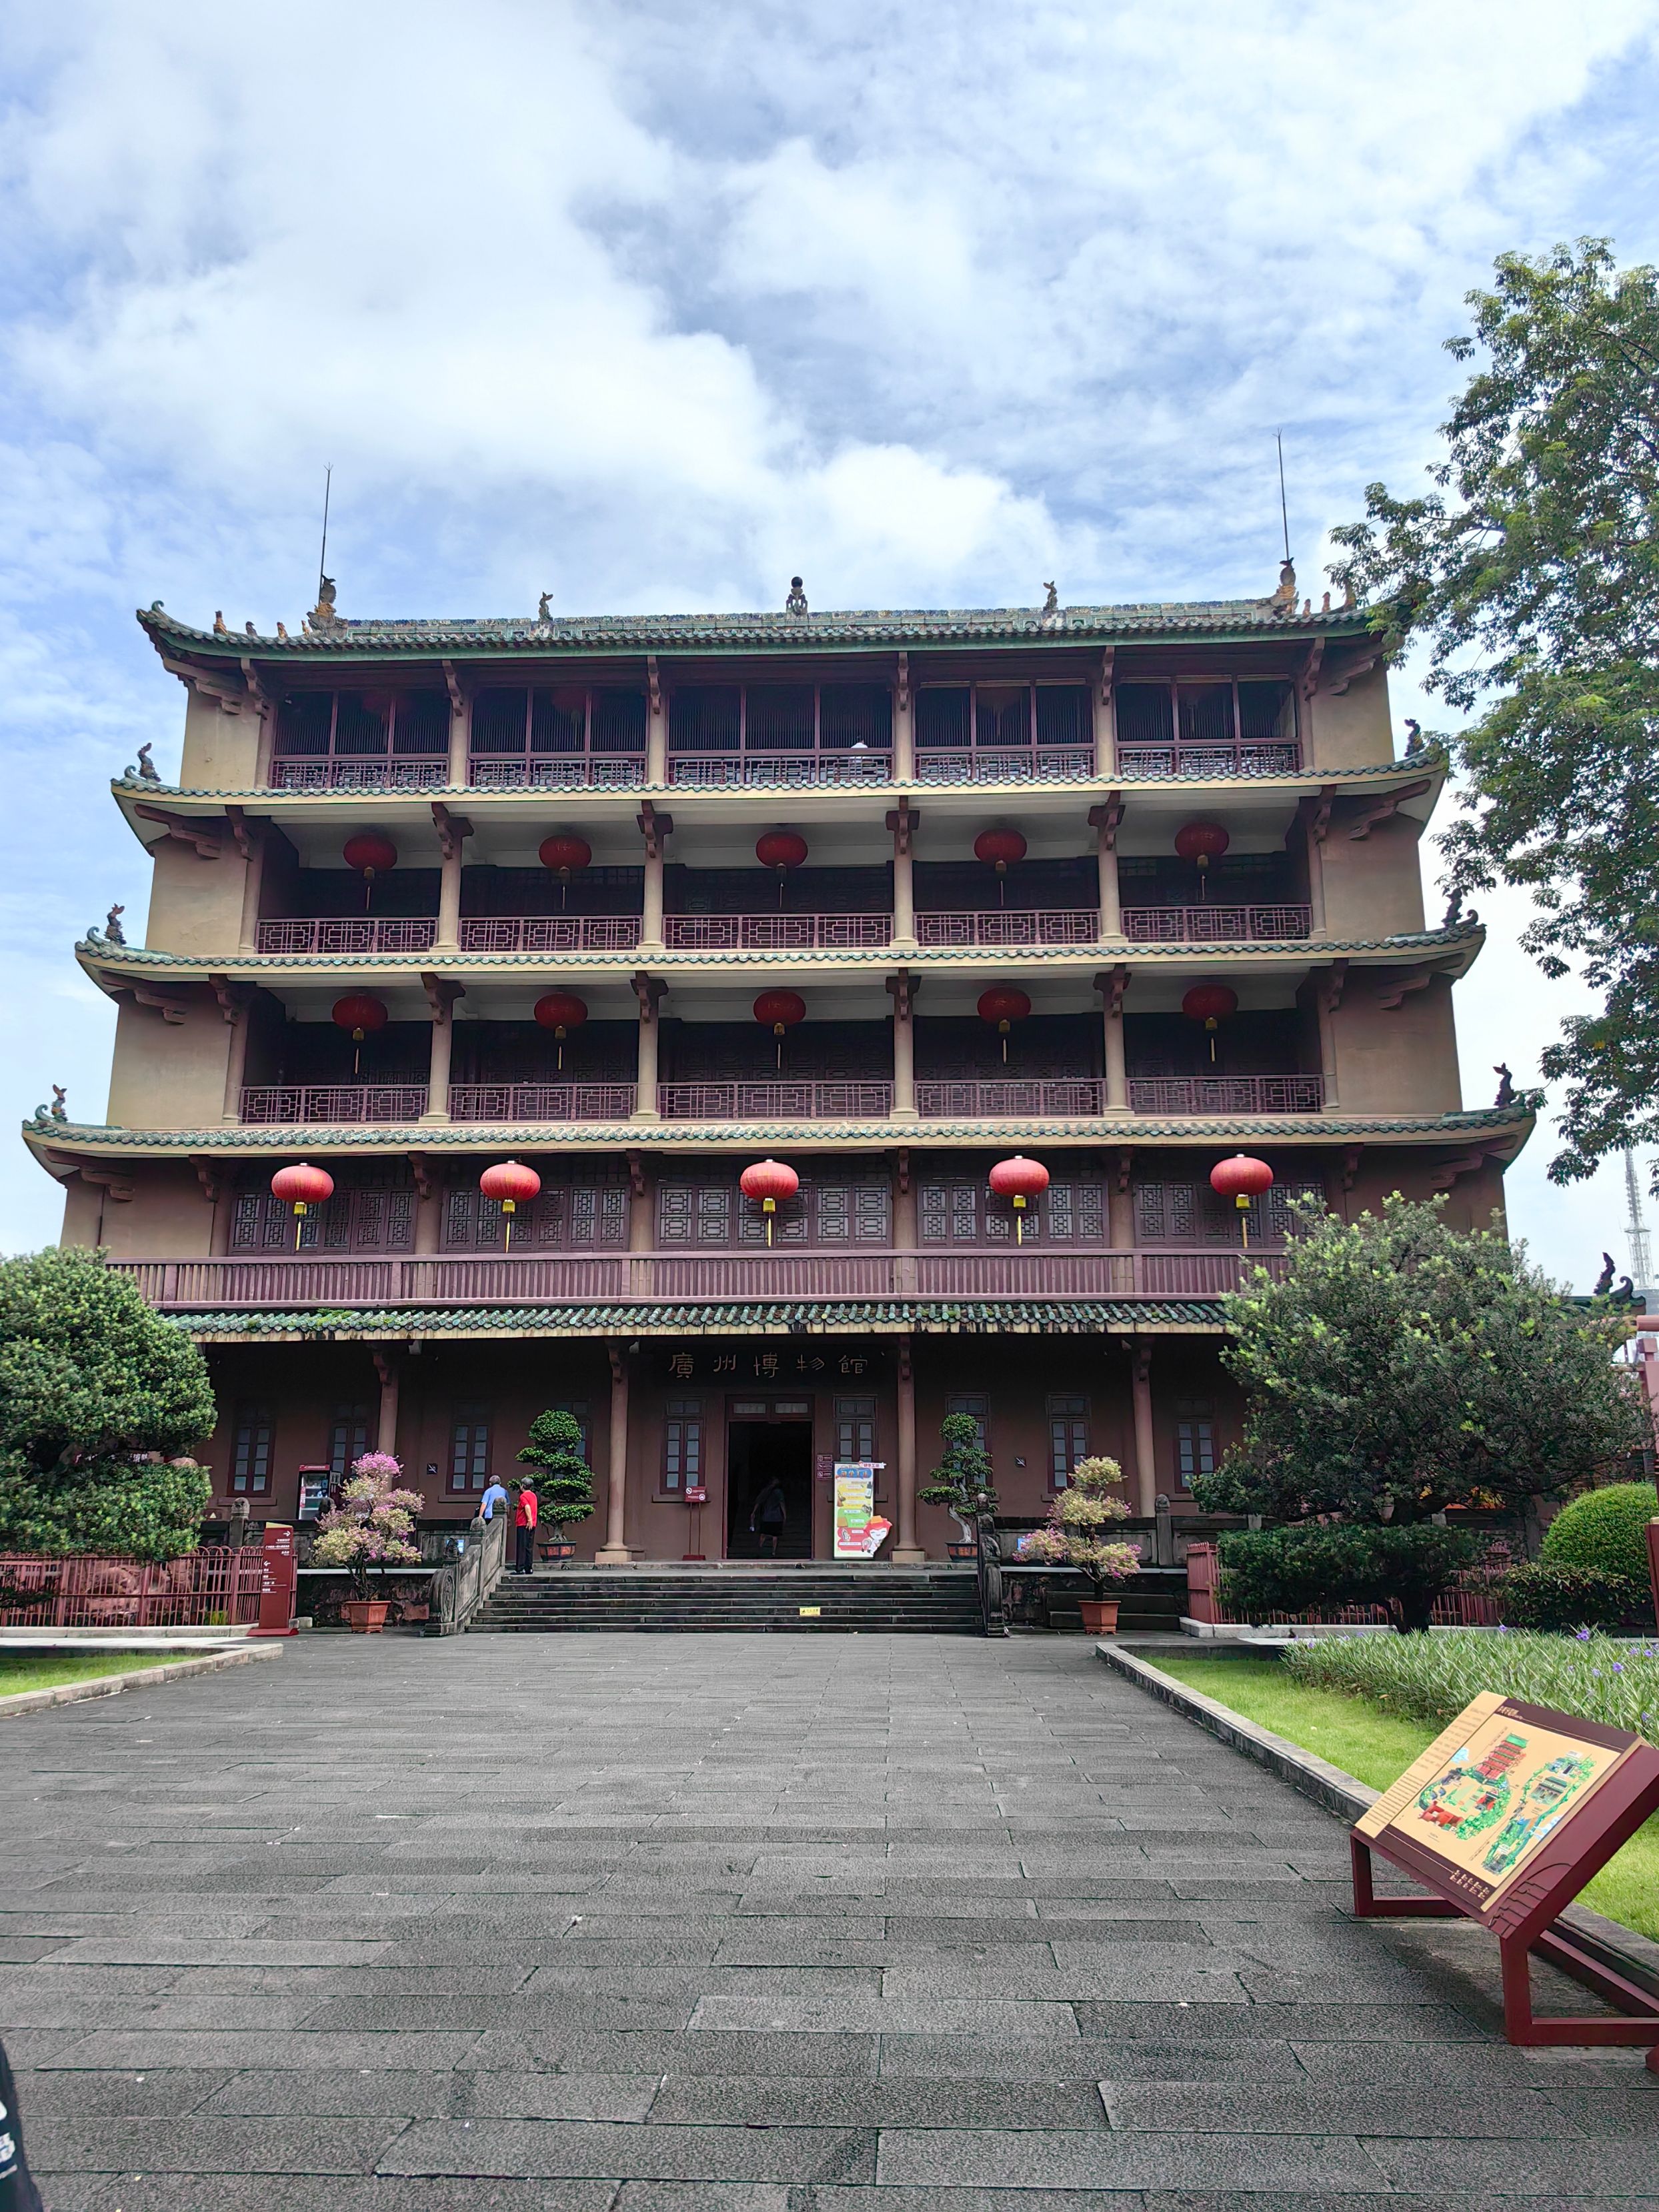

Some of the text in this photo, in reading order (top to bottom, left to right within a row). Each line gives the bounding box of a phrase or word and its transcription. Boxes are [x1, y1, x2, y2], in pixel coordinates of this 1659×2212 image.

[668, 1352, 868, 1378] 廣州博物館
